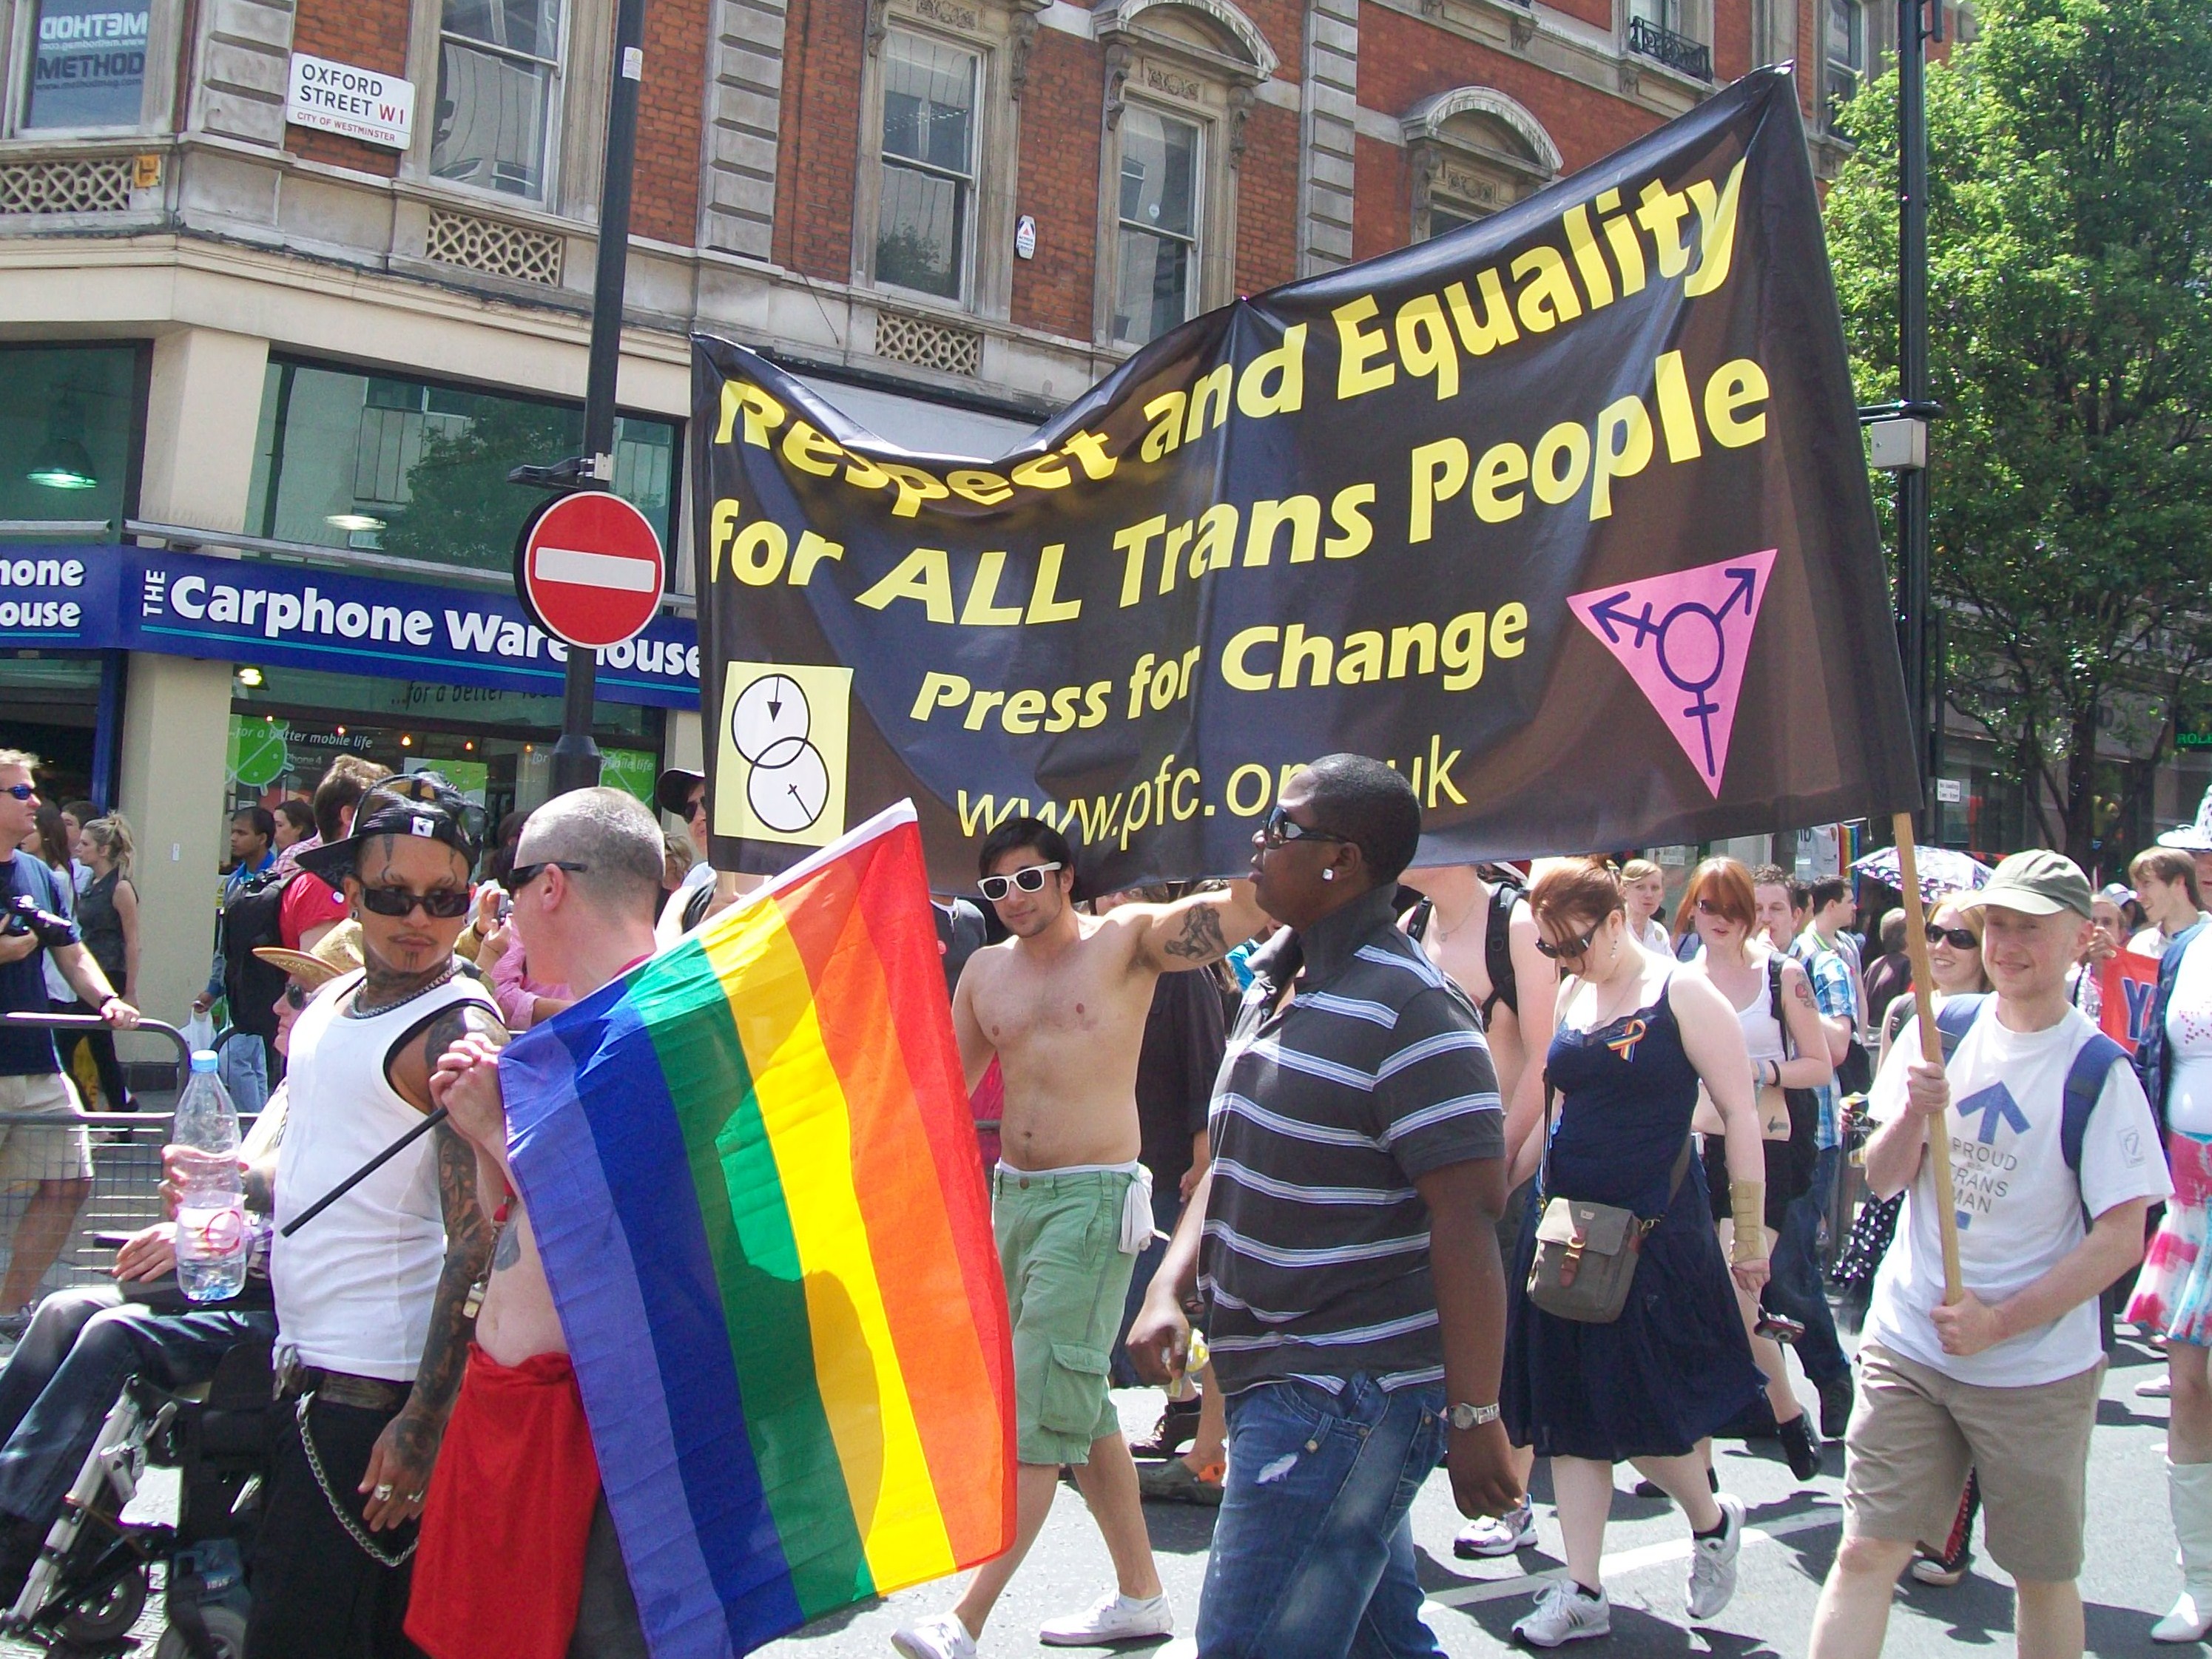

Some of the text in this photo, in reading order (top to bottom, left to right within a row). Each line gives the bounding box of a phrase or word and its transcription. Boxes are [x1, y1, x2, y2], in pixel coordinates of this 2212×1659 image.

[37, 52, 145, 79] METHOD
[302, 64, 382, 97] OXFORD
[300, 85, 373, 116] STREET
[297, 112, 395, 142] CITY OF WESTMINSTER
[715, 156, 1747, 517] Respect and Equality
[711, 350, 1770, 626] for ALL Trans People
[142, 570, 166, 617] THE
[171, 575, 434, 646] Carphone
[909, 601, 1528, 734] Press for Change
[257, 729, 265, 738] a
[309, 732, 350, 746] mobile
[354, 736, 373, 751] life
[315, 755, 322, 764] 4
[1952, 1136, 2017, 1172] PROUD
